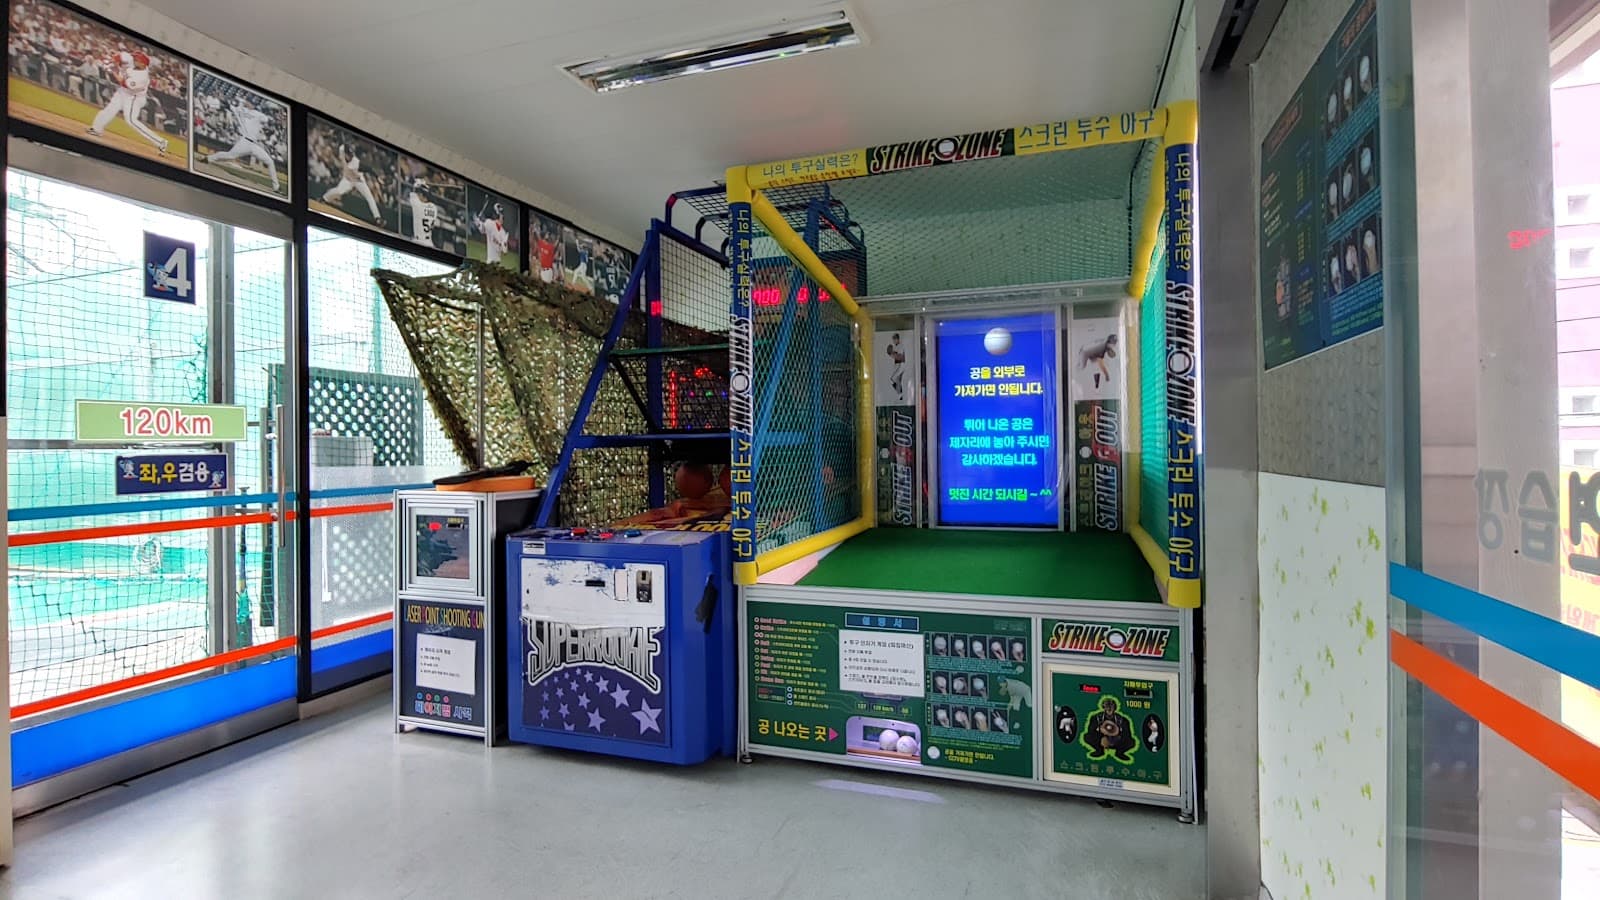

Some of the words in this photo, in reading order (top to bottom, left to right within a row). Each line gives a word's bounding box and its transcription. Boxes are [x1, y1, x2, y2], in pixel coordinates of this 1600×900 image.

[1018, 121, 1067, 149] 스크린
[1077, 115, 1110, 142] 투수
[1120, 109, 1154, 135] 야구
[762, 165, 786, 178] 나의
[791, 153, 858, 175] 투구실력은?
[870, 137, 938, 174] STRIKE
[953, 129, 1003, 162] ZONE
[1174, 152, 1191, 181] 나의
[737, 209, 750, 233] 나의
[1174, 188, 1192, 272] 투구실력은?
[163, 247, 192, 297] 4
[737, 237, 750, 307] 투구실력은?
[1165, 280, 1195, 353] STRIKE
[969, 367, 991, 379] 공을
[993, 365, 1025, 378] 외부로
[954, 384, 996, 397] 가져가면
[1166, 375, 1196, 426] ZONE
[120, 406, 213, 436] 120km
[892, 410, 912, 447] OUT
[988, 418, 1009, 431] 나온
[1011, 417, 1033, 430] 공은
[1094, 405, 1118, 447] OUT
[949, 436, 991, 448] 제자리에
[1017, 435, 1050, 448] 주시면
[1167, 429, 1194, 484] 스크린
[139, 460, 210, 485] 좌,우겸용
[731, 438, 751, 483] 스크린
[732, 490, 751, 520] 투수
[891, 463, 913, 526] STRIKE
[949, 488, 969, 500] 멋진
[972, 488, 993, 500] 시간
[995, 488, 1027, 501] 되시길
[1094, 463, 1119, 531] STRIKE
[1168, 492, 1194, 527] 투수
[732, 528, 752, 558] 야구
[1168, 536, 1194, 574] 야구
[440, 608, 471, 628] SHOOTING
[1049, 622, 1111, 653] STRIKE
[1120, 627, 1170, 657] ZONE
[758, 719, 770, 734] 공
[774, 721, 811, 740] 나오는
[814, 725, 827, 742] 곳
